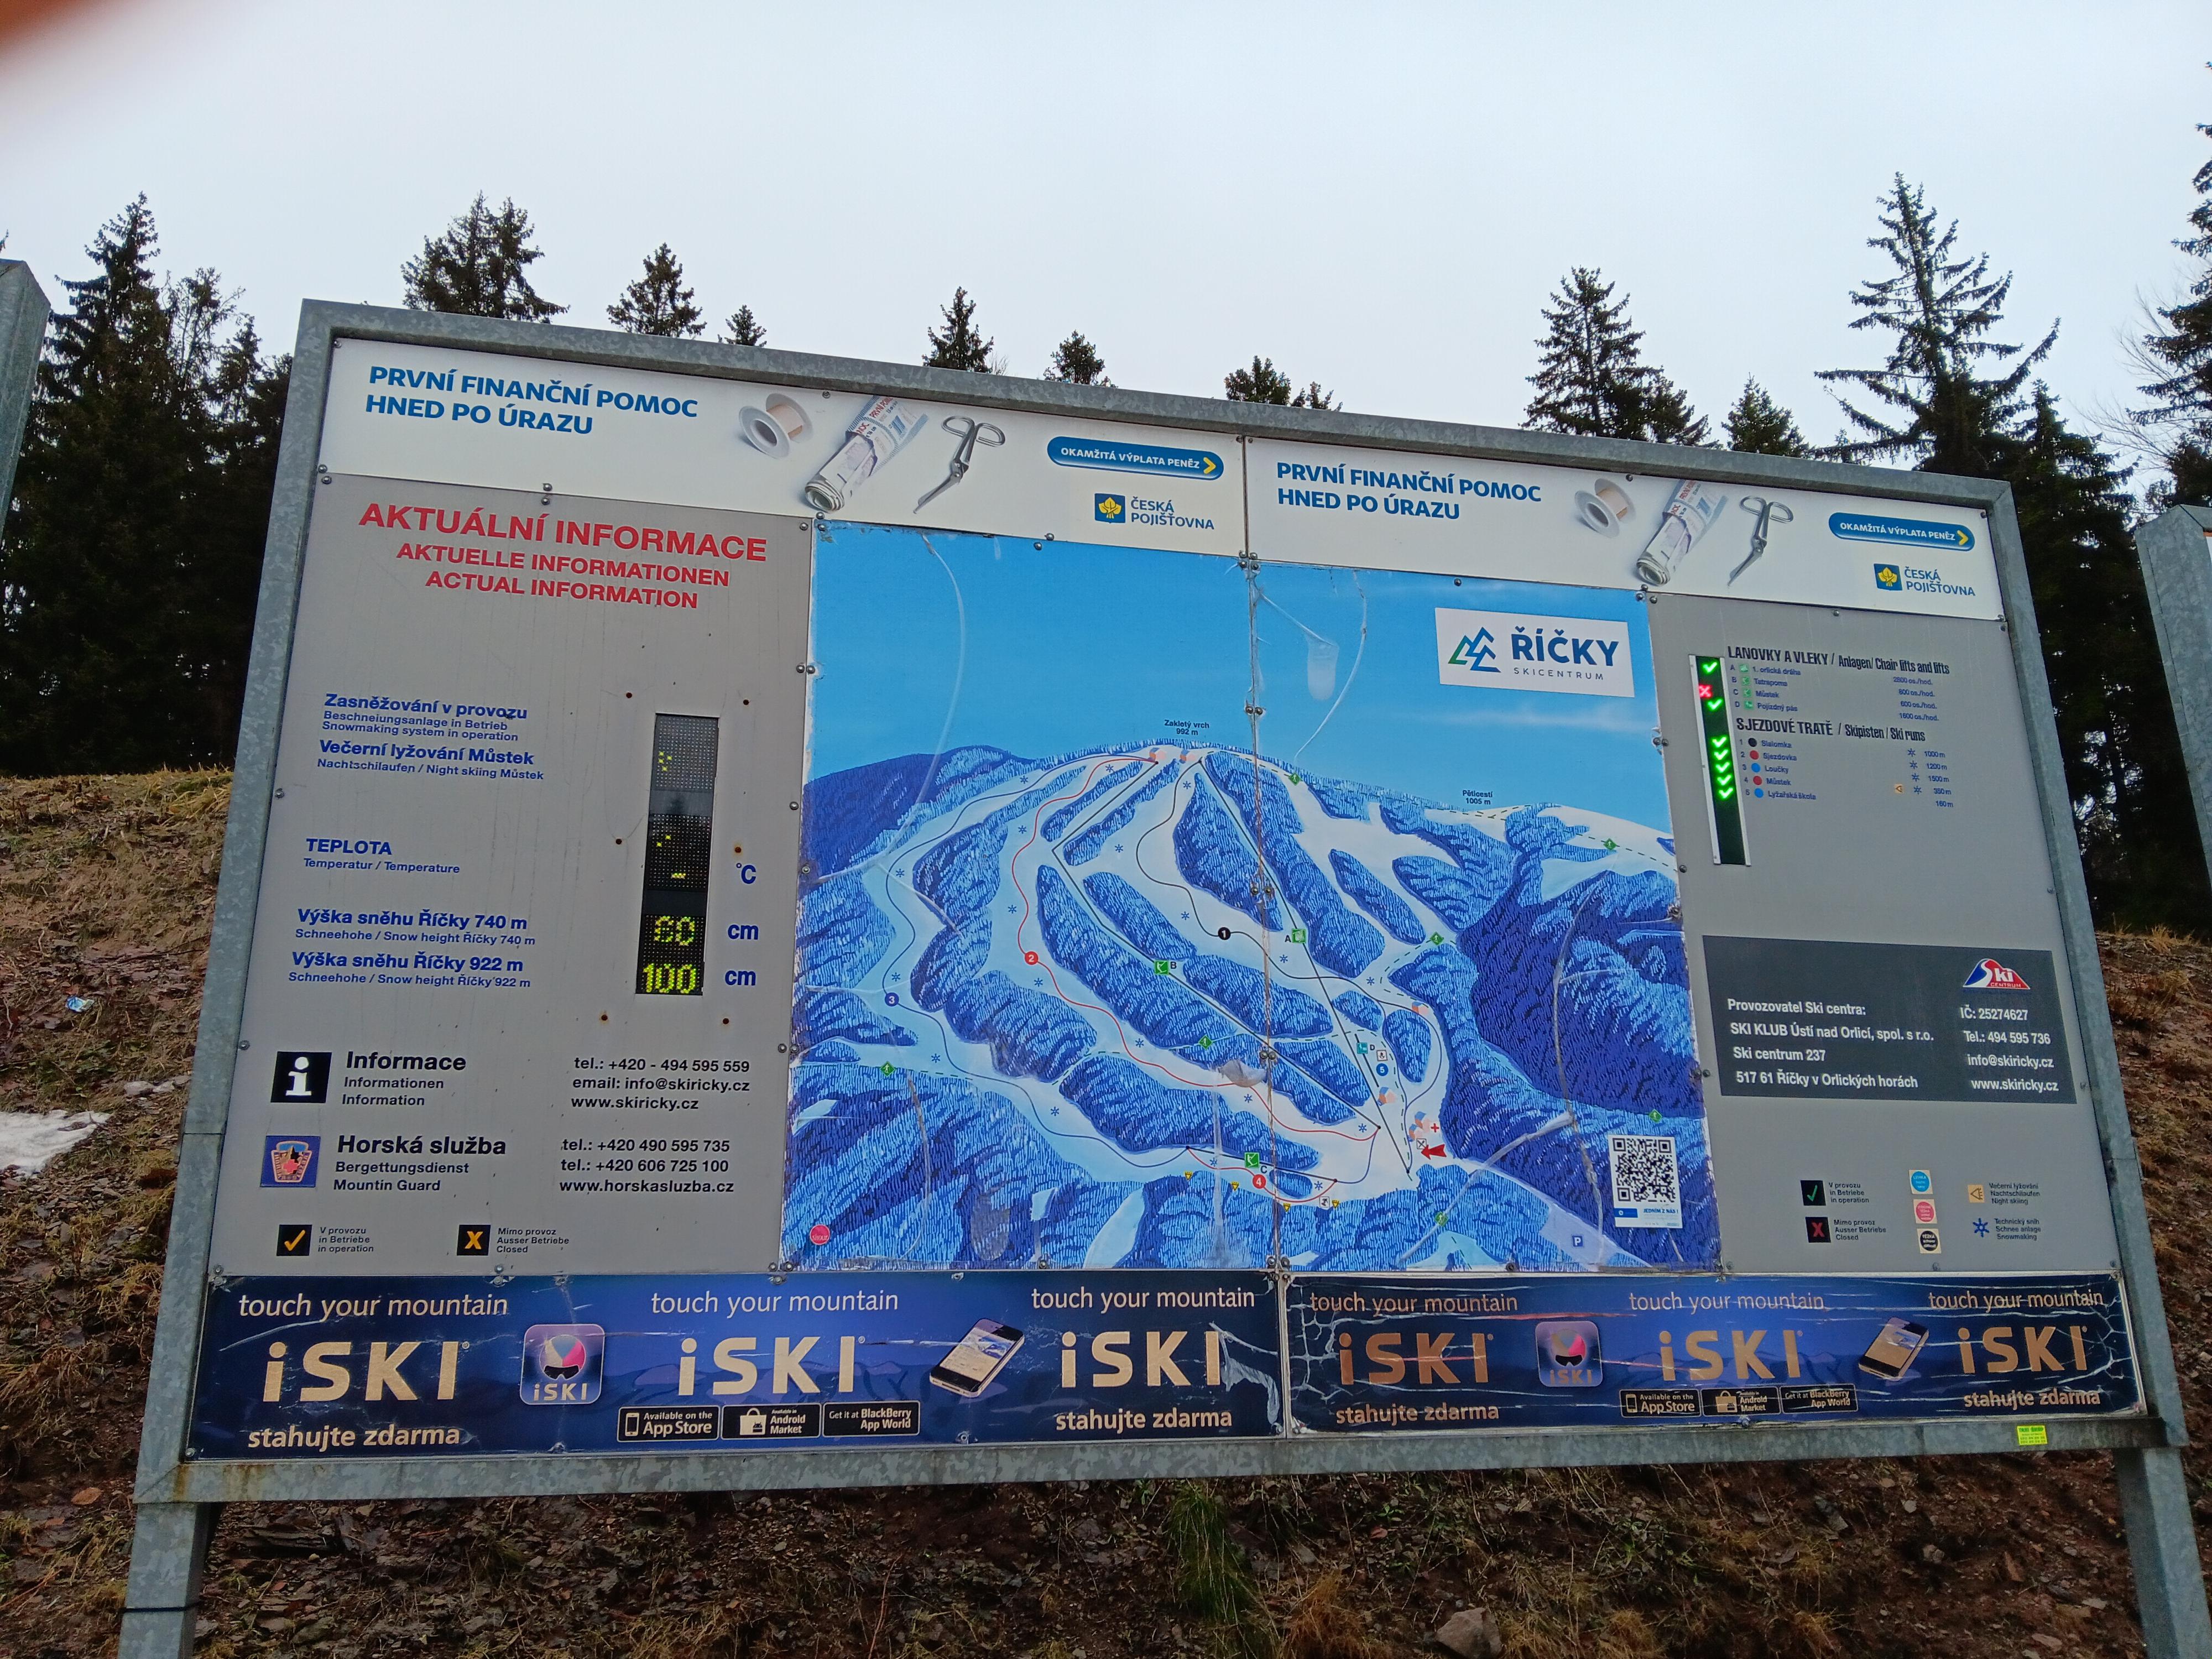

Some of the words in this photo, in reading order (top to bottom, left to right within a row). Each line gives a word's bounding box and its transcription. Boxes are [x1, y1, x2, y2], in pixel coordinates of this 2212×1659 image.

[370, 366, 453, 391] PRVNÍ
[461, 375, 589, 405] FINANČNÍ
[597, 390, 697, 417] POMOC
[366, 395, 444, 418] HNED
[452, 403, 491, 423] PO
[499, 408, 592, 434] ÚRAZU
[1061, 448, 1116, 460] OKAMŽITÁ
[1119, 454, 1165, 465] VÝPLATA
[1168, 458, 1199, 468] PENĚZ
[1277, 462, 1344, 484] PRVNÍ
[1350, 469, 1453, 493] FINANČNÍ
[1459, 479, 1541, 502] POMOC
[1131, 497, 1174, 515] ČESKÁ
[1279, 488, 1340, 508] HNED
[1347, 494, 1378, 512] PO
[1384, 498, 1459, 519] ÚRAZU
[1131, 513, 1214, 529] POJIŠŤOVNA
[359, 504, 547, 541] AKTUÁLNÍ
[556, 520, 766, 561] INFORMACE
[1840, 523, 1886, 533] OKAMŽITÁ
[1888, 528, 1927, 537] VÝPLATA
[1928, 531, 1955, 540] PENĚZ
[397, 544, 525, 568] AKTUELLE
[532, 555, 728, 586] INFORMATIONEN
[1905, 566, 1940, 582] ČESKÁ
[425, 571, 524, 594] ACTUAL
[531, 580, 697, 608] INFORMATION
[1906, 581, 1975, 596] POJIŠŤOVNA
[1511, 628, 1619, 666] ŘÍČKY
[1728, 646, 1780, 661] LANOVKY
[1785, 651, 1792, 662] A
[1793, 651, 1828, 665] VLEKY
[1514, 667, 1603, 680] SKICENTRUM
[325, 693, 439, 712] Zasněžování
[442, 705, 451, 713] v
[456, 706, 527, 719] provozu
[324, 711, 447, 728] Beschneiungsanlage
[451, 719, 461, 727] in
[465, 720, 507, 730] Betrieb
[1736, 718, 1795, 734] SJEZDOVÉ
[1797, 722, 1833, 735] TRATĚ
[322, 721, 398, 735] Snowmaking
[403, 728, 444, 736] system
[448, 729, 458, 737] in
[462, 732, 518, 740] operation
[320, 740, 388, 755] Večerní
[391, 744, 466, 760] lyžování
[469, 748, 534, 764] Můstek
[306, 838, 392, 855] TEPLOTA
[304, 858, 373, 869] Temperatur
[384, 862, 460, 873] Temperature
[298, 909, 352, 925] Výška
[358, 911, 413, 925] sněhu
[419, 909, 470, 930] Říčky
[475, 915, 506, 928] 740
[511, 920, 526, 929] m
[296, 929, 372, 940] Schneehohe
[375, 931, 381, 940] /
[384, 931, 418, 941] Snow
[421, 933, 460, 944] height
[463, 932, 497, 945] Říčky
[501, 936, 521, 944] 740
[728, 925, 758, 940] cm
[643, 963, 696, 994] 100
[725, 971, 755, 985] cm
[1728, 999, 1803, 1013] Provozovatel
[1806, 1002, 1823, 1013] Ski
[1827, 1004, 1865, 1016] centra:
[1960, 1008, 1976, 1019] IČ:
[1979, 1008, 2028, 1020] 25274627
[347, 1051, 466, 1070] Informace
[1734, 1047, 1754, 1058] Ski
[1755, 1049, 1803, 1061] centrum
[1806, 1050, 1825, 1061] 237
[1968, 1054, 2055, 1070] info@skiricky.cz
[575, 1057, 603, 1069] tel.:
[609, 1058, 645, 1070] +420
[661, 1060, 687, 1071] 494
[692, 1060, 718, 1071] 595
[723, 1061, 749, 1072] 559
[345, 1077, 443, 1088] Informationen
[573, 1077, 620, 1088] email:
[625, 1077, 749, 1093] info@skiricky.cz
[1971, 1079, 2058, 1093] www.skiricky.cz
[342, 1094, 424, 1105] Information
[571, 1097, 698, 1111] www.skiricky.cz
[338, 1135, 422, 1154] Horská
[430, 1136, 505, 1154] služba
[561, 1139, 592, 1150] tel.:
[598, 1139, 634, 1151] +420
[639, 1140, 666, 1151] 490
[671, 1140, 698, 1151] 595
[703, 1140, 729, 1152] 735
[336, 1162, 469, 1175] Bergettungsdienst
[334, 1180, 392, 1190] Mountin
[398, 1180, 440, 1191] Guard
[560, 1180, 733, 1194] www.horskasluzba.cz
[238, 1293, 311, 1316] touch
[321, 1296, 382, 1322] your
[388, 1293, 508, 1316] mountain
[1928, 1291, 1978, 1308] touch
[1984, 1295, 2022, 1313] your
[2028, 1289, 2103, 1307] mountain
[1958, 1326, 2087, 1374] iSKI
[263, 1342, 458, 1401] iSKI
[1964, 1390, 2034, 1410] stahujte
[2039, 1387, 2101, 1405] zdarma
[643, 1422, 672, 1437] App
[675, 1421, 712, 1434] Store
[248, 1425, 355, 1452] stahujte
[363, 1424, 459, 1445] zdarma
